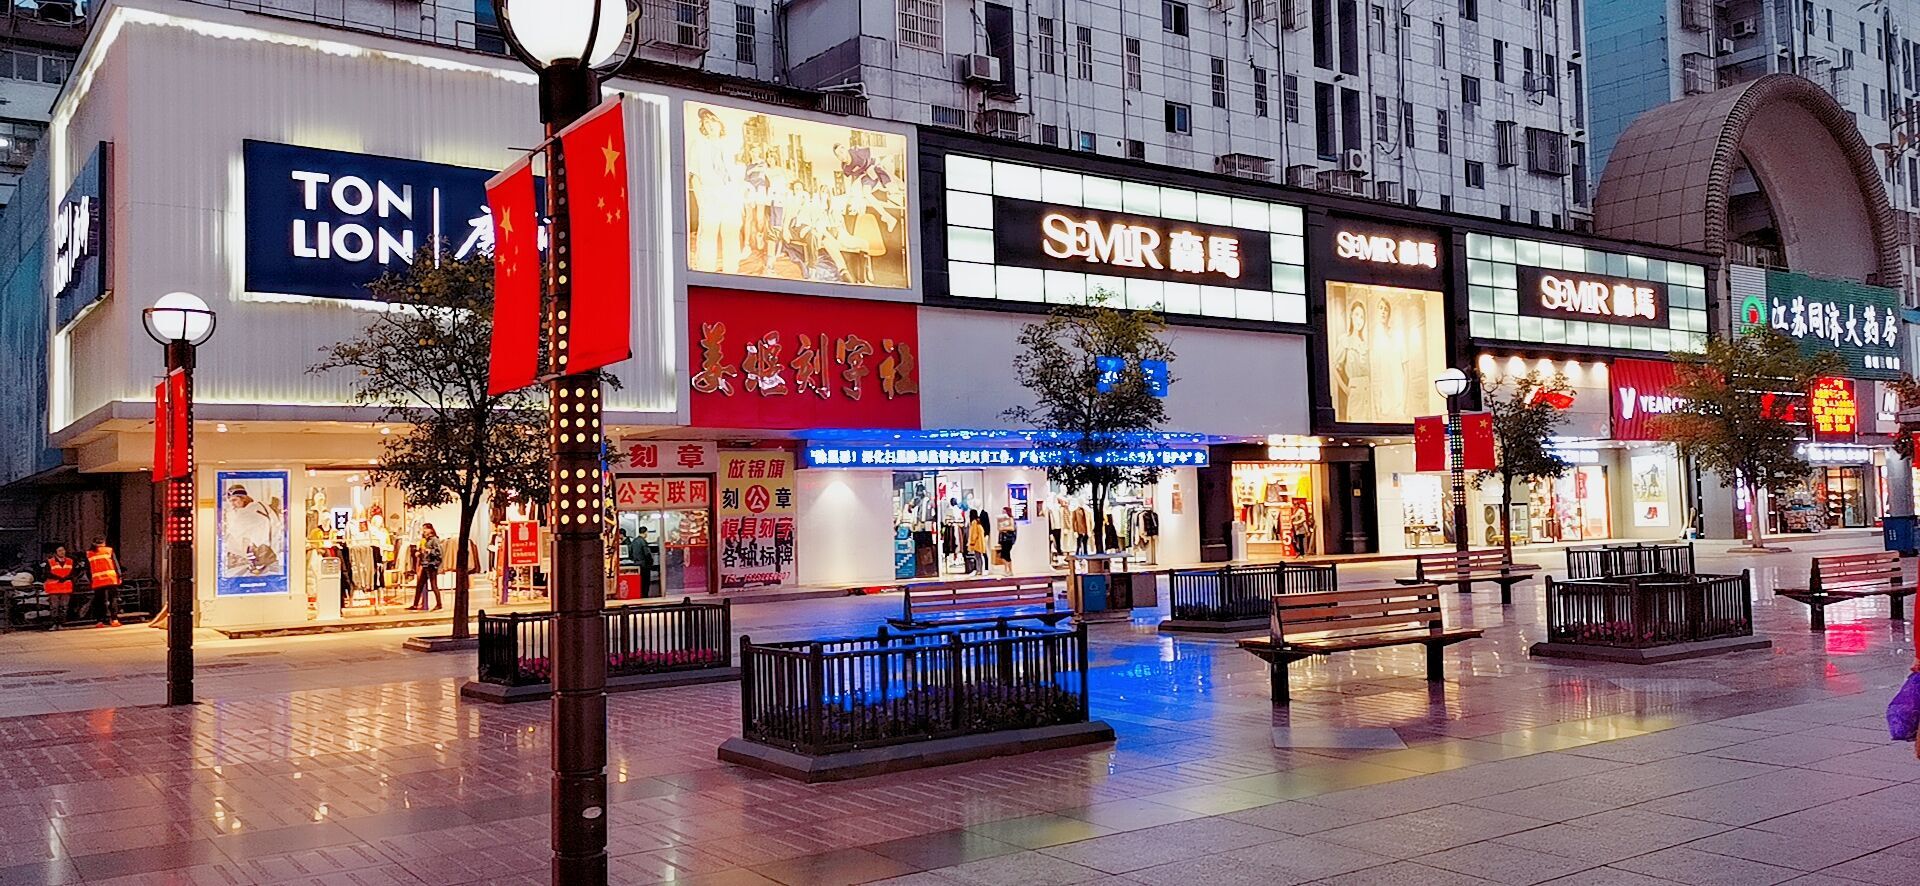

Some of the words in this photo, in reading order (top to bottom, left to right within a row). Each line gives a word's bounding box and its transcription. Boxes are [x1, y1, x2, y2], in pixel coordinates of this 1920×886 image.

[291, 170, 412, 221] TON
[292, 218, 413, 266] LION
[1042, 213, 1164, 270] SEMIR
[1337, 231, 1399, 264] SEMIR
[1540, 275, 1611, 315] SEMIR
[1771, 295, 1898, 348] 江苏同济大药房
[629, 444, 704, 468] 刻章
[728, 459, 786, 479] 做锦旗
[618, 480, 707, 505] 公安联网
[721, 517, 794, 540] 模具刻字
[722, 545, 794, 570] 各种标牌
